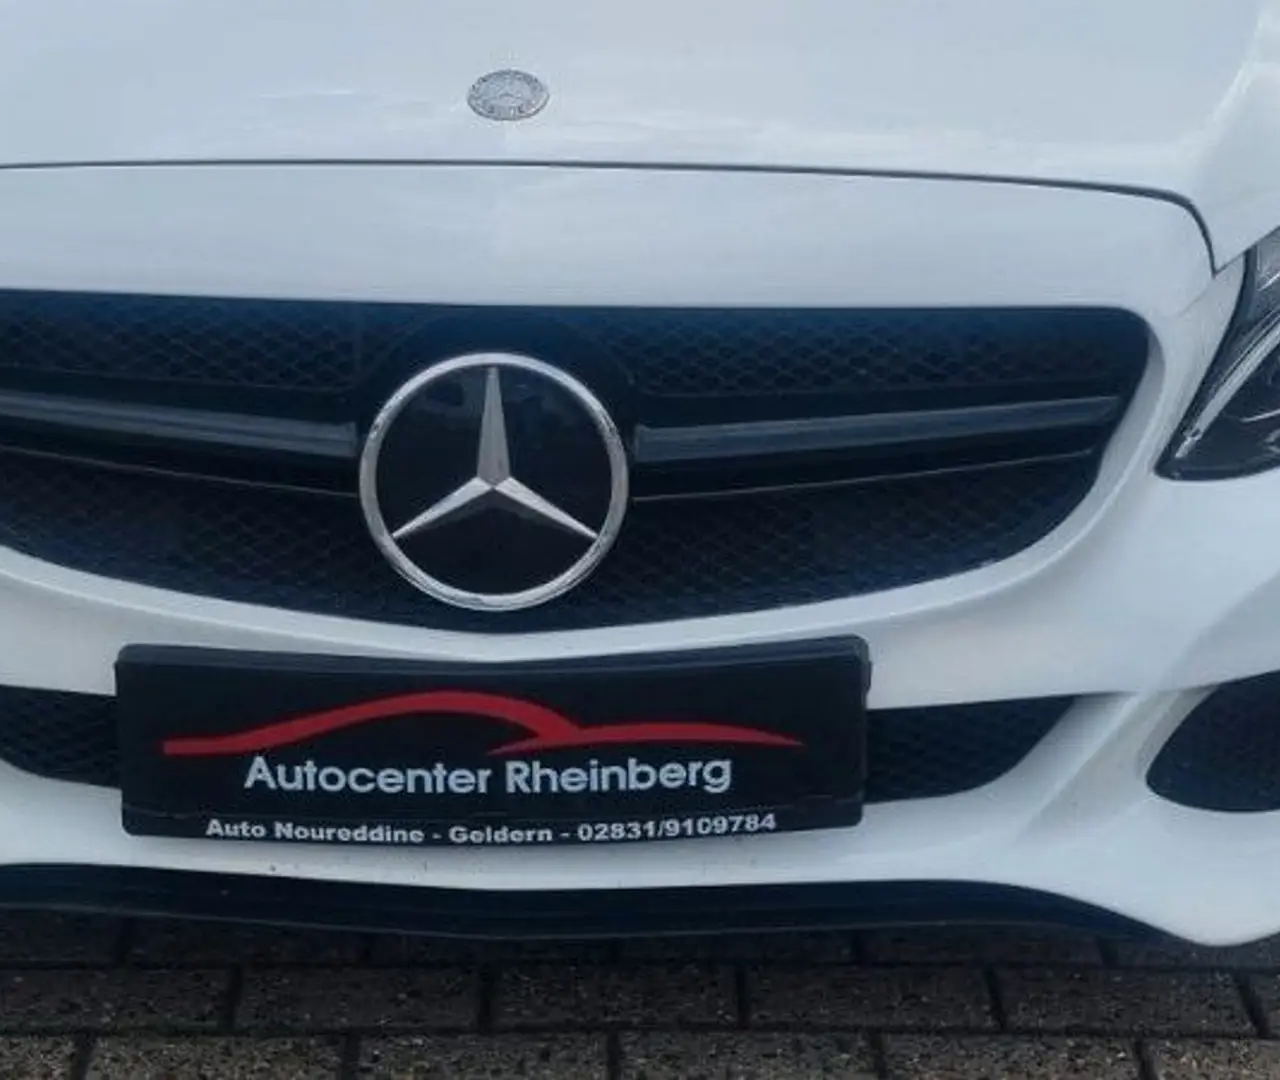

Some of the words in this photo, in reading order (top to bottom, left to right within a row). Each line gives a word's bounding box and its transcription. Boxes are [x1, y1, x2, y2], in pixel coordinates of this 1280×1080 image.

[243, 755, 492, 794] Autocenter
[505, 756, 732, 794] Rheinberg
[206, 819, 267, 839] Auto
[274, 821, 425, 843] Noureddine
[448, 825, 553, 844] Geldern
[576, 813, 777, 842] 02831/9109784
